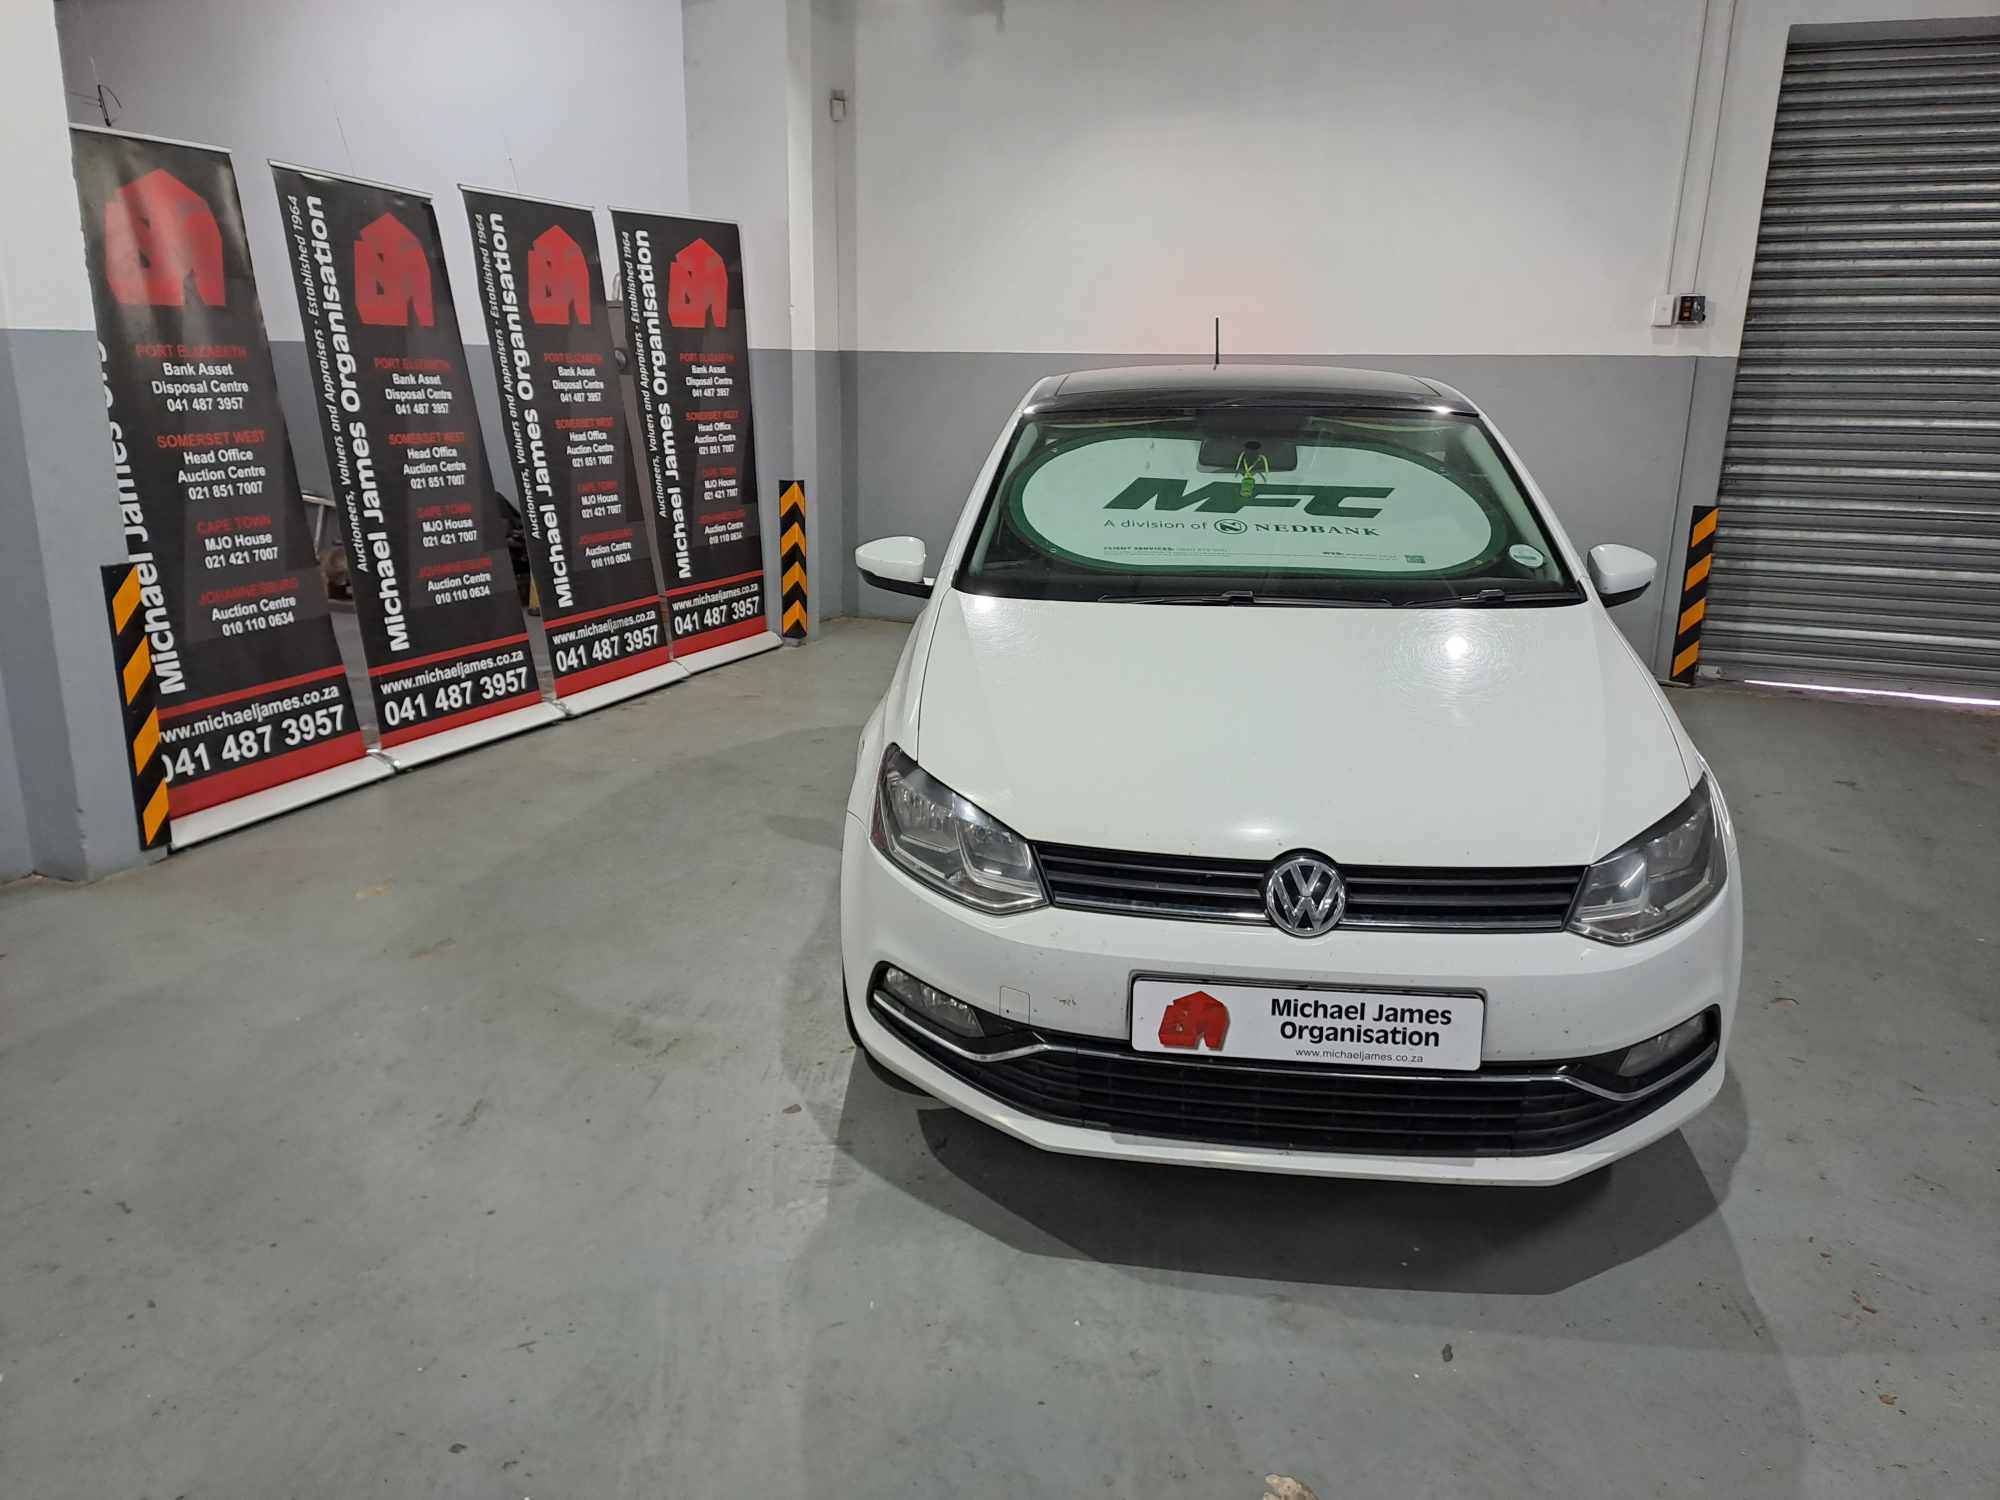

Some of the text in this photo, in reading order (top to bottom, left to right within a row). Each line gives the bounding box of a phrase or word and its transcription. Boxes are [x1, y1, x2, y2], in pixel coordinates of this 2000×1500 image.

[475, 213, 488, 245] 1964
[480, 247, 500, 319] Established
[163, 362, 233, 376] Bank Asset
[495, 328, 514, 393] Appraisers
[152, 380, 249, 396] Disposal Centre
[288, 195, 369, 573] Auctioneers, Valuers and Appraisers Established 1964
[392, 373, 442, 385] Bank Asset
[552, 379, 583, 391] Disposal
[167, 397, 243, 412] 041 487 3957
[385, 388, 453, 402] Disposal Centre
[635, 229, 692, 580] Michael James Organisation
[395, 403, 449, 415] 041 487 3957
[489, 213, 574, 609] Michael James Organisation
[505, 393, 517, 419] and
[306, 195, 410, 652] Michael James Organisation
[646, 413, 658, 452] Valuers
[157, 429, 265, 448] SOMERSET WEST
[511, 420, 527, 464] Valuers
[569, 430, 607, 442] Head Office
[694, 434, 718, 444] Auction
[183, 448, 253, 465] Head Office
[407, 446, 458, 460] Head Office
[566, 443, 614, 456] Auction Centre
[177, 466, 266, 484] Auction Centre
[403, 461, 467, 476] Auction Centre
[188, 481, 263, 500] 021 851 7007
[410, 474, 465, 490] 021 851 7007
[581, 493, 619, 506] MJO House
[1102, 477, 1395, 519] MFC
[594, 506, 606, 517] 421
[422, 518, 473, 533] MJO House
[704, 524, 727, 535] Auction
[1103, 518, 1382, 537] A division of NEDBANK
[204, 533, 273, 551] MJO House
[422, 530, 478, 548] 021 421 7007
[205, 547, 279, 569] 021 421 7007
[585, 541, 632, 557] Auction Centre
[427, 572, 491, 592] Auction Centre
[435, 585, 491, 606] 010 110 0634
[672, 583, 759, 611] www.michaeljames.co.za
[212, 596, 297, 621] Auction Centre
[674, 595, 760, 635] 041 487 3957
[129, 552, 187, 696] Michael
[222, 611, 295, 637] 010 110 0634
[552, 610, 656, 645] www.michaeljames.co.za
[556, 624, 658, 672] 041 487 3957
[380, 650, 524, 695] www.michaeljames.co.za
[384, 666, 528, 727] 041 487 3957
[221, 724, 273, 763] 487
[281, 704, 345, 746] 3957
[1271, 998, 1452, 1025] Michael James
[1280, 1021, 1440, 1047] Organisation
[1295, 1049, 1424, 1063] www.michaeljames.co.za
